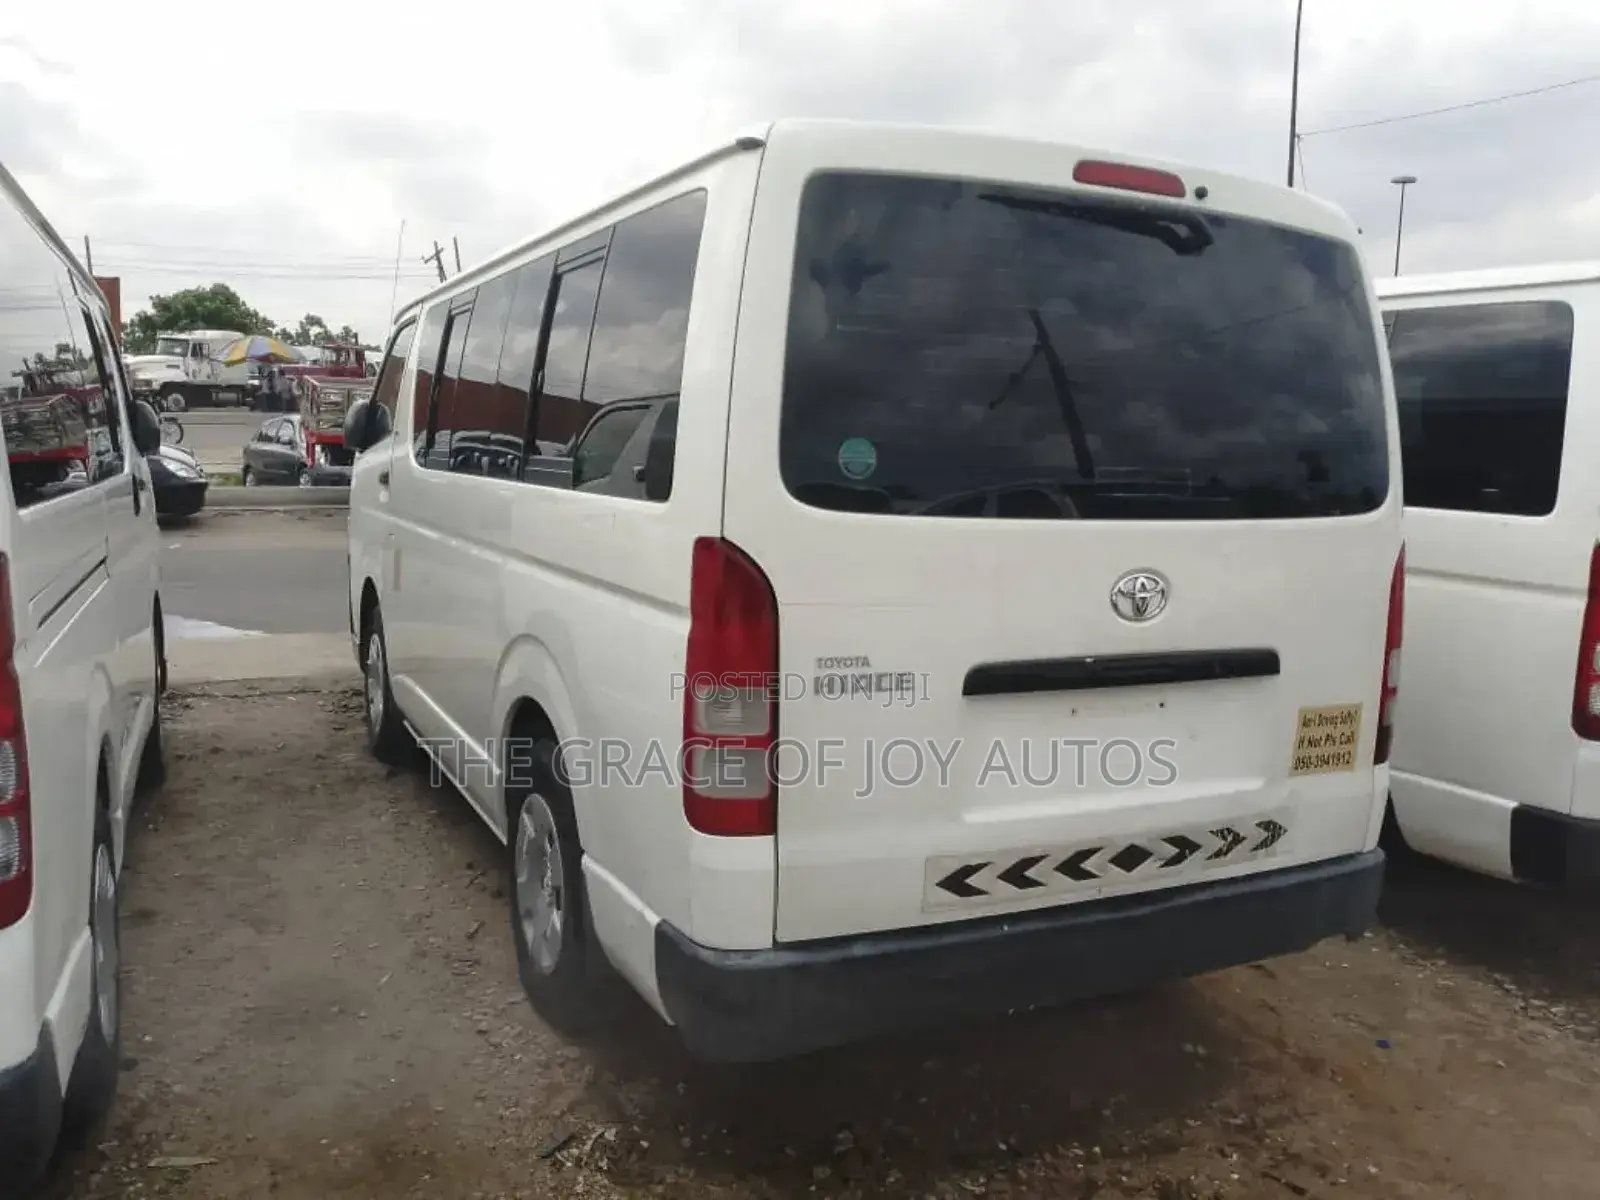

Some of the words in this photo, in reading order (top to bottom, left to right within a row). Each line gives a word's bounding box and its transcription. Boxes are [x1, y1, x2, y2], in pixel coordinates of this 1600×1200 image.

[815, 655, 872, 669] TOYOTA
[1307, 734, 1322, 748] Not
[1339, 731, 1354, 745] Call
